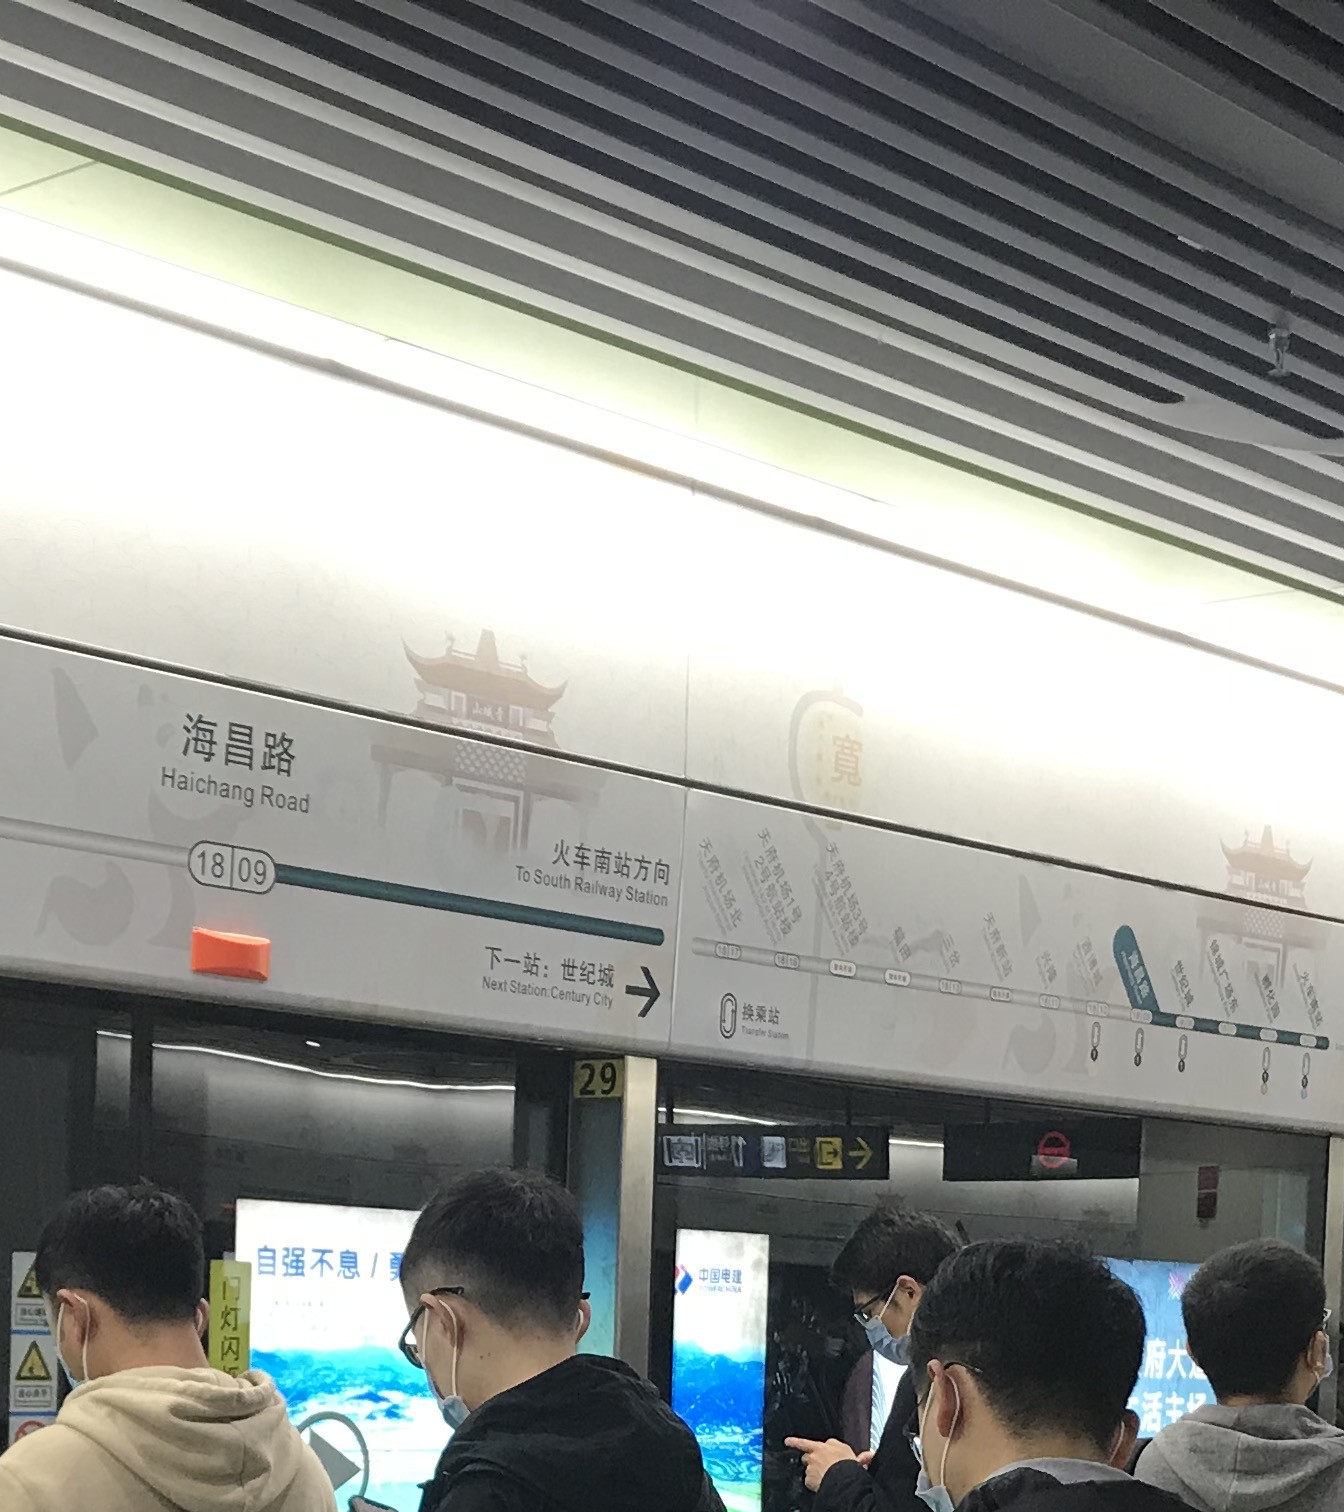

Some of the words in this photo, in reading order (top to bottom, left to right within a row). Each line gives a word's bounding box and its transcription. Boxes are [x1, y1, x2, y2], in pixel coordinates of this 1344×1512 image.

[182, 713, 296, 777] 海昌路
[160, 766, 255, 808] Haichang
[260, 784, 310, 814] Road
[197, 849, 225, 878] 18
[238, 856, 267, 885] 09
[552, 838, 670, 886] 火车南站方向
[757, 827, 803, 924] 天府机场1号
[515, 865, 531, 883] To
[533, 868, 571, 891] South
[573, 876, 623, 902] Railway
[625, 885, 669, 907] Station
[698, 836, 744, 928] 天府机场北
[482, 975, 508, 993] Next
[593, 991, 614, 1010] City
[741, 1002, 780, 1025] 换乘站
[578, 1062, 618, 1097] 29
[257, 1245, 360, 1280] 自强不息
[699, 1268, 742, 1284] 中国电建
